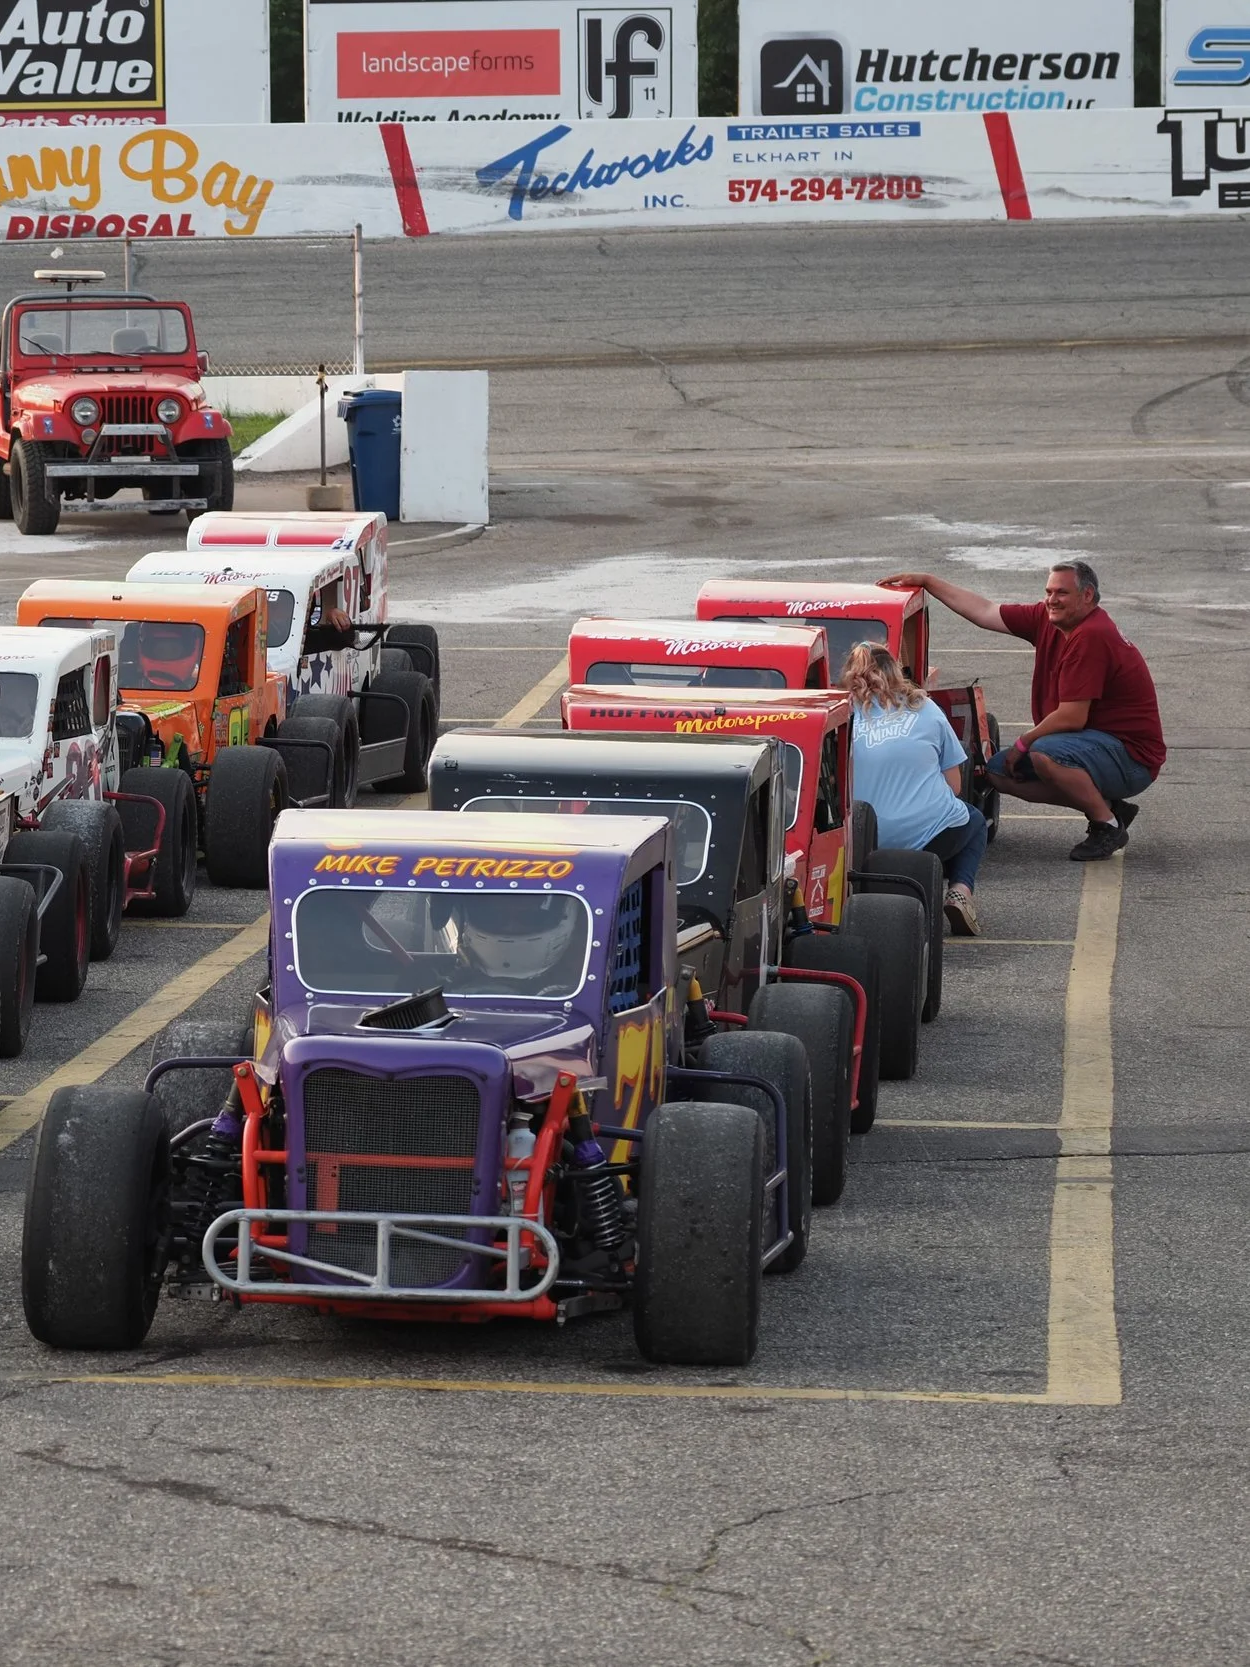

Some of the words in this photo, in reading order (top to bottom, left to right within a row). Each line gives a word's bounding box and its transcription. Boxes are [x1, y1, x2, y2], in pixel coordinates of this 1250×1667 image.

[855, 48, 1120, 83] Hutcherson
[643, 87, 656, 100] 11
[854, 85, 1066, 112] Construction
[737, 125, 829, 140] TRAILER
[840, 122, 911, 137] SALES
[733, 151, 820, 164] ELKHART
[834, 150, 853, 162] IN
[119, 129, 274, 236] Bay
[475, 124, 714, 221] Techworks
[728, 175, 924, 203] 574-294-7200
[643, 195, 691, 209] INC.
[5, 213, 196, 240] DISPOSAL
[331, 539, 354, 551] 24
[590, 708, 714, 719] HOFFMAN
[674, 711, 809, 734] Motorsports
[314, 855, 400, 875] MIKE
[412, 857, 574, 879] PETRIZZO
